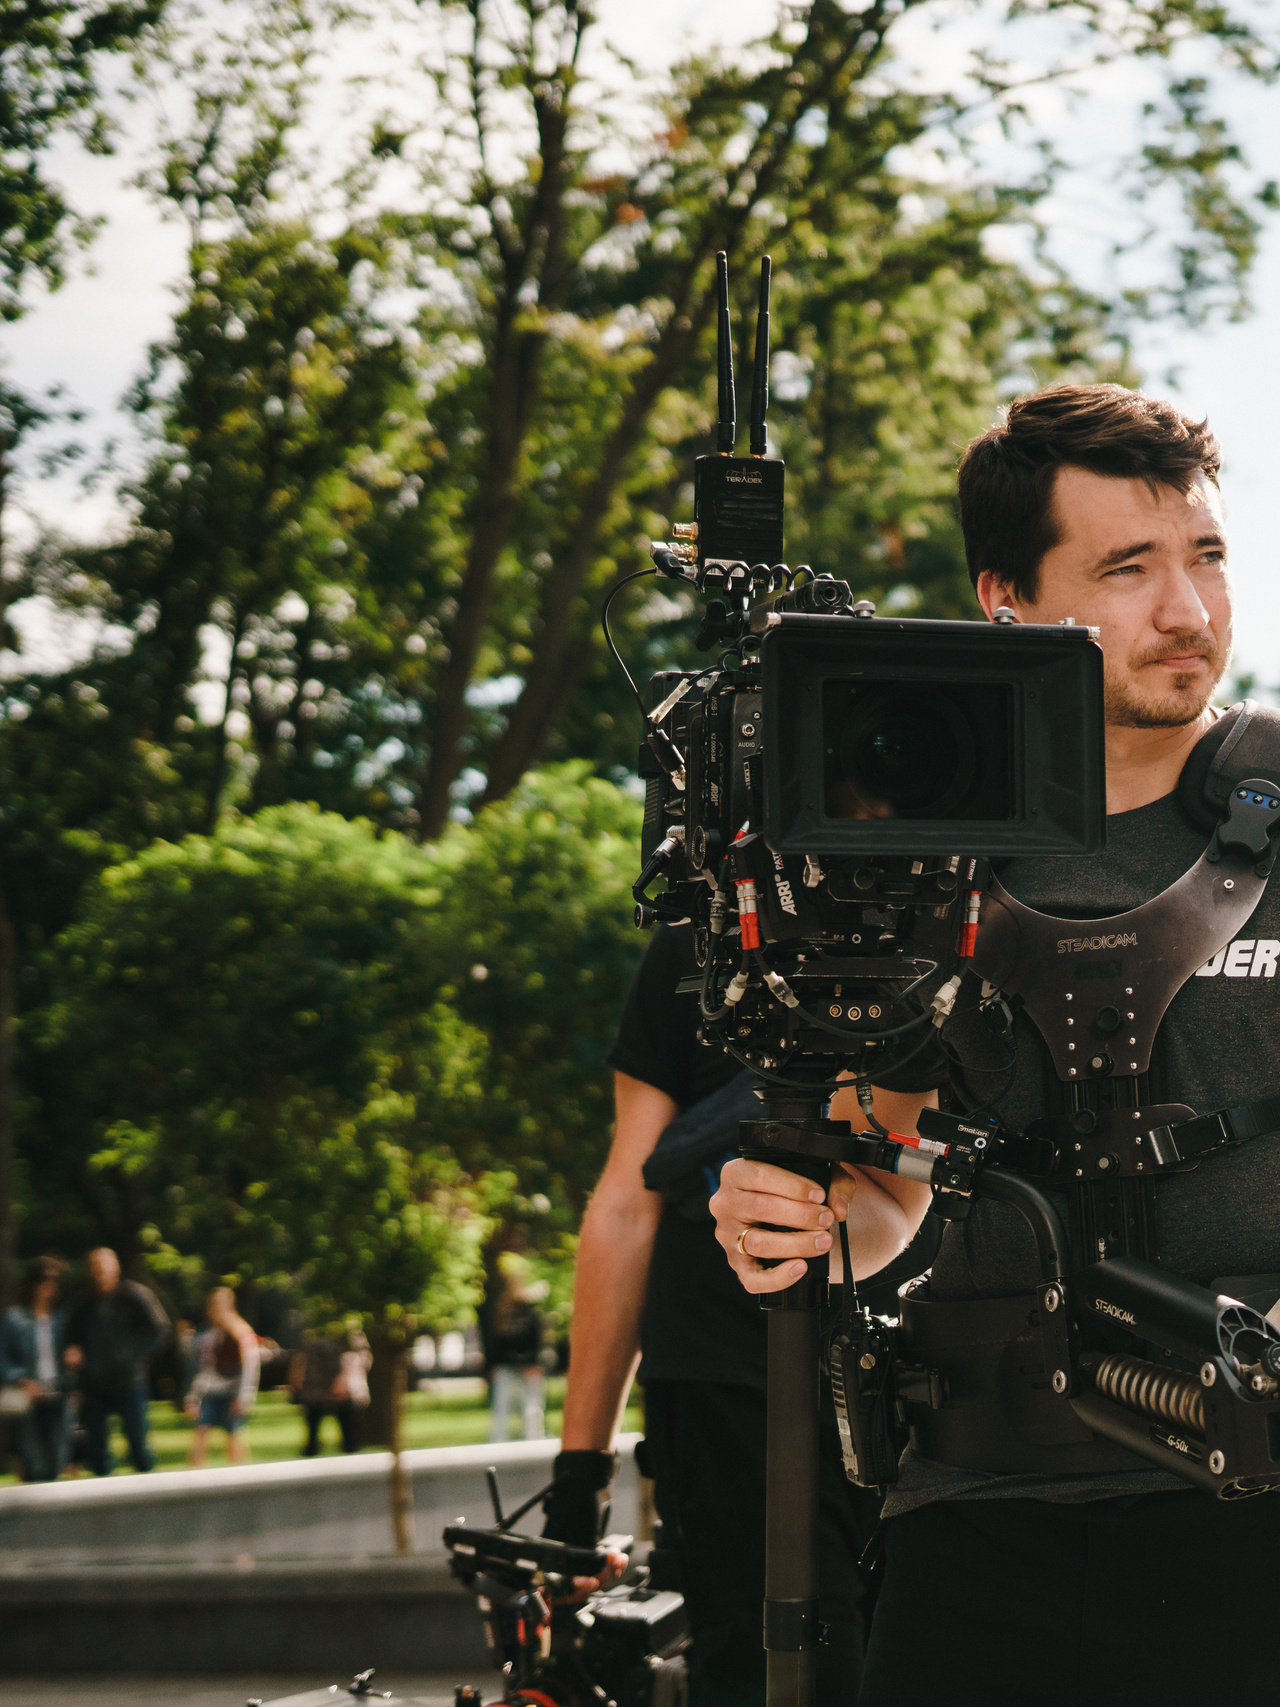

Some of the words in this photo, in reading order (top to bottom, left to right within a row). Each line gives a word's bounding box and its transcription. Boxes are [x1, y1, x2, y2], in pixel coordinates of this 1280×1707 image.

[726, 476, 762, 484] TERADEK
[711, 781, 719, 803] ARRI
[776, 880, 798, 916] ARRI
[1057, 932, 1138, 954] STEADICAM
[1095, 1298, 1136, 1325] STEADICAM
[1167, 1434, 1189, 1453] G-50x
